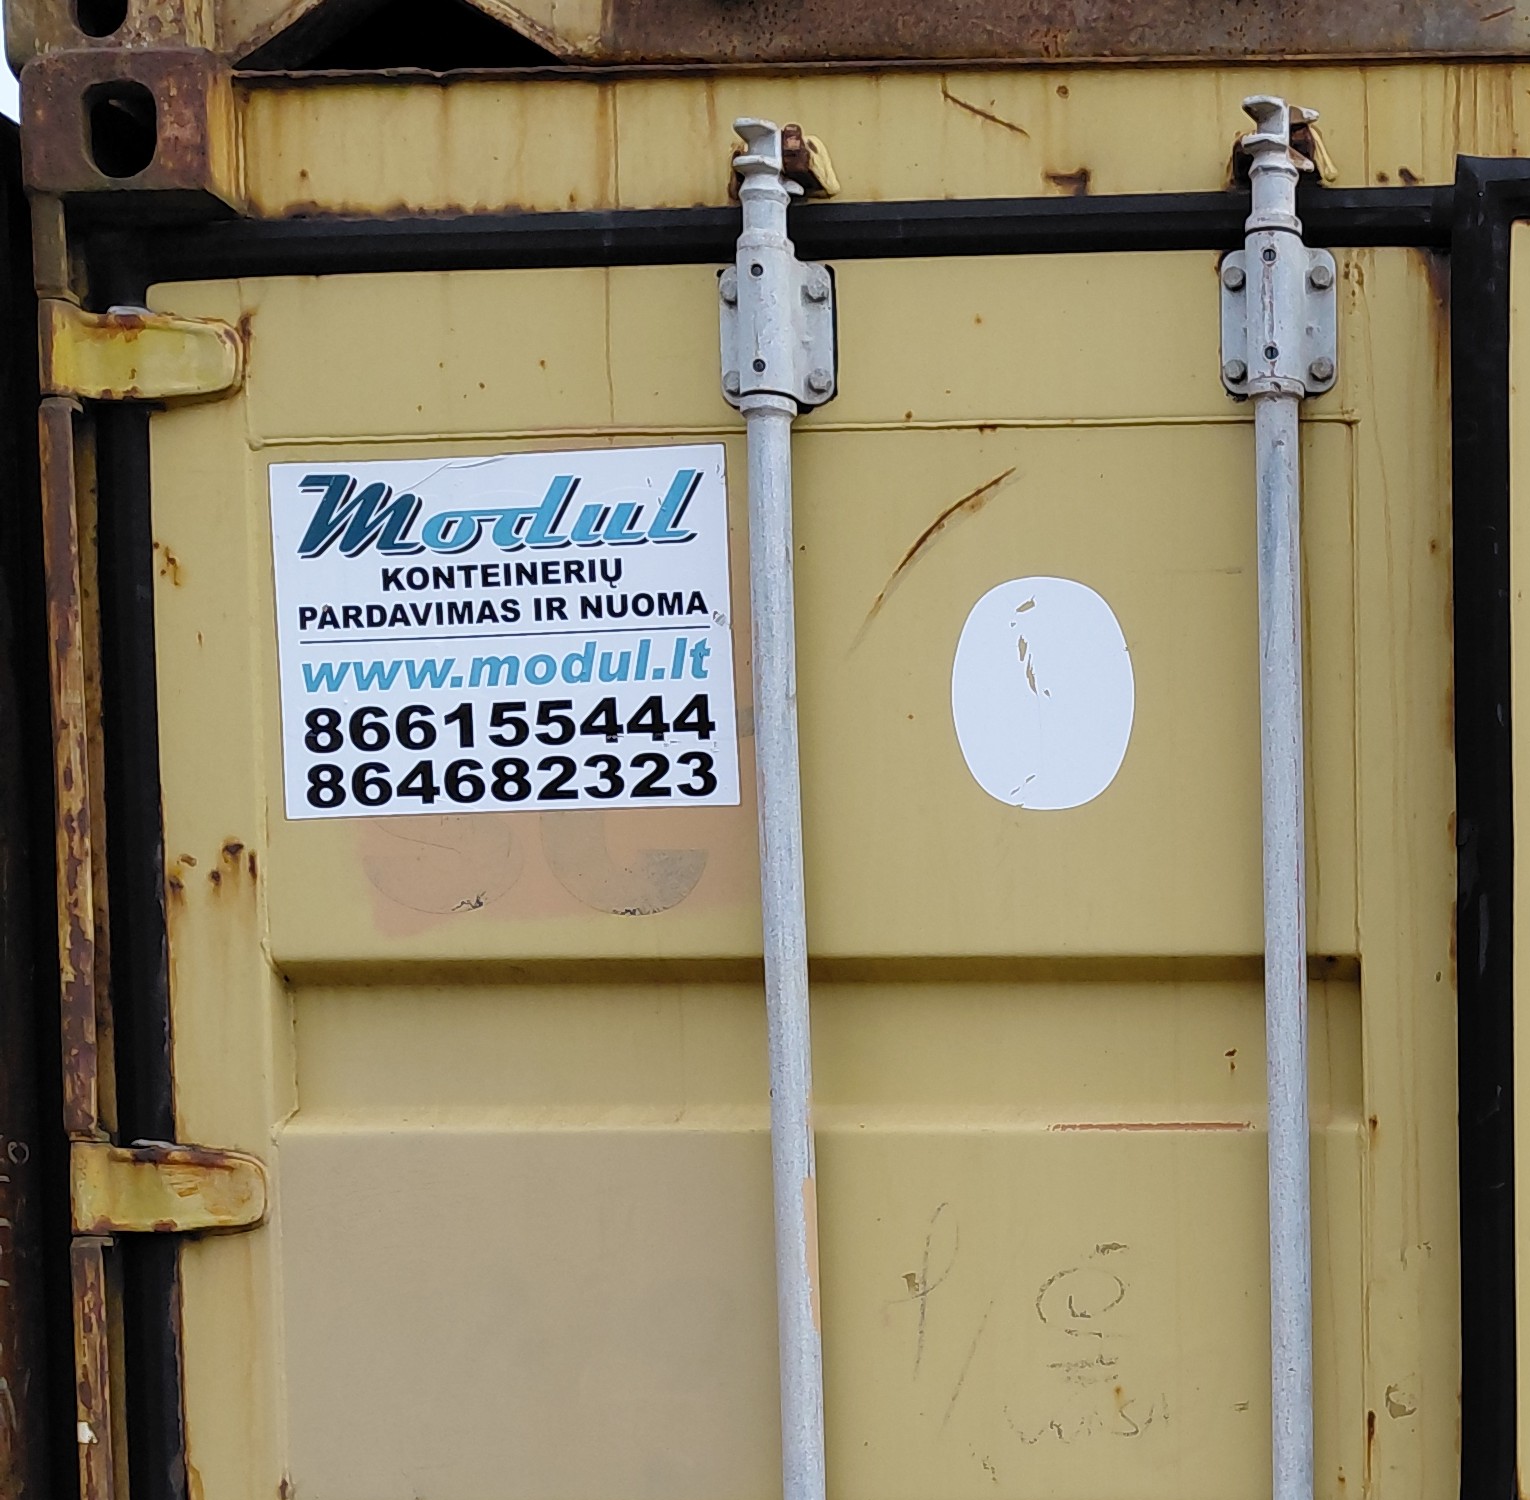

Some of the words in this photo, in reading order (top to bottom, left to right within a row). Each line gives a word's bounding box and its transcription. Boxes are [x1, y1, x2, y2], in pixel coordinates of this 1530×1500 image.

[297, 467, 705, 561] Modul
[381, 557, 624, 592] KONTEINERIŲ
[298, 597, 521, 631] PARDAVIMAS
[534, 596, 567, 623] IR
[580, 590, 709, 621] NUOMA
[302, 636, 711, 695] www.modul.lt
[303, 693, 717, 754] 866155444
[305, 752, 718, 809] 864682323
